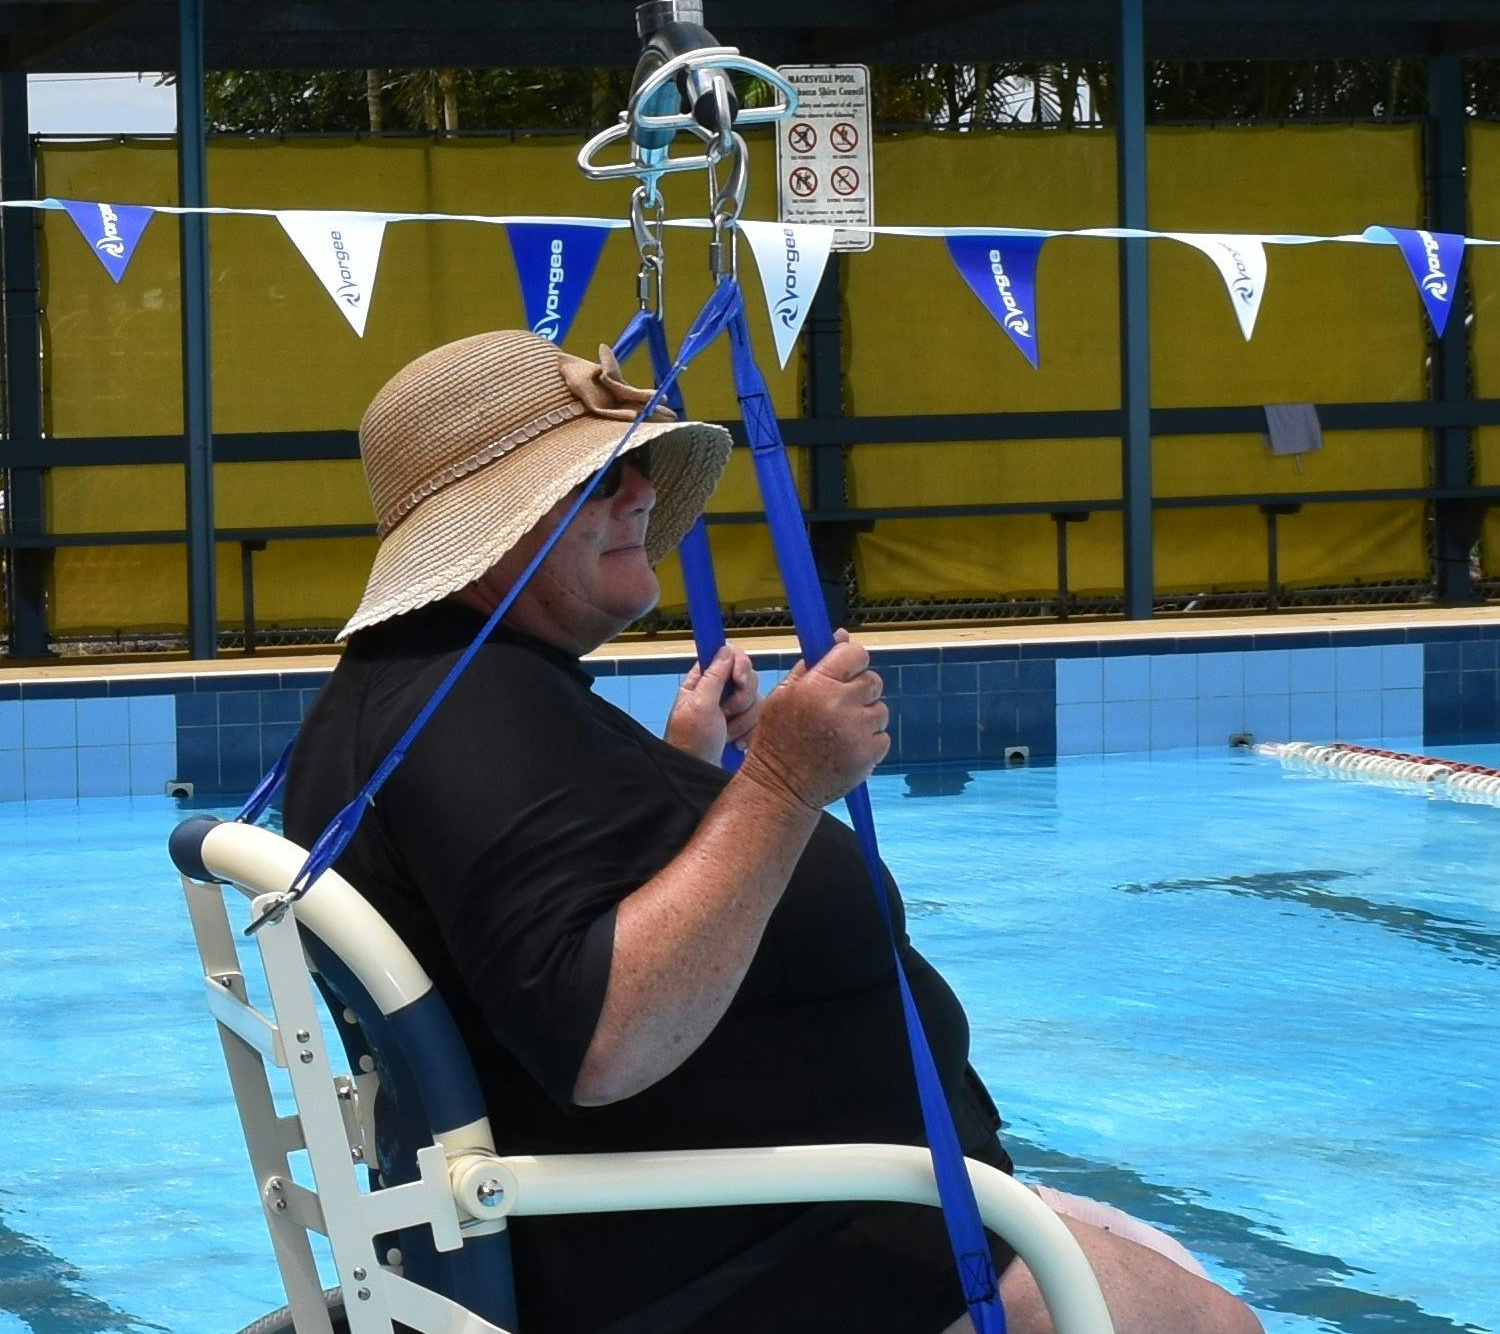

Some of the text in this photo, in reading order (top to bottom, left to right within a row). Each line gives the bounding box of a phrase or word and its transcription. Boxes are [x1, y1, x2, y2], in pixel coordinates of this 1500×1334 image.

[331, 230, 358, 295] vorgee
[532, 239, 564, 333] vorgee
[989, 249, 1023, 327] vorgee
